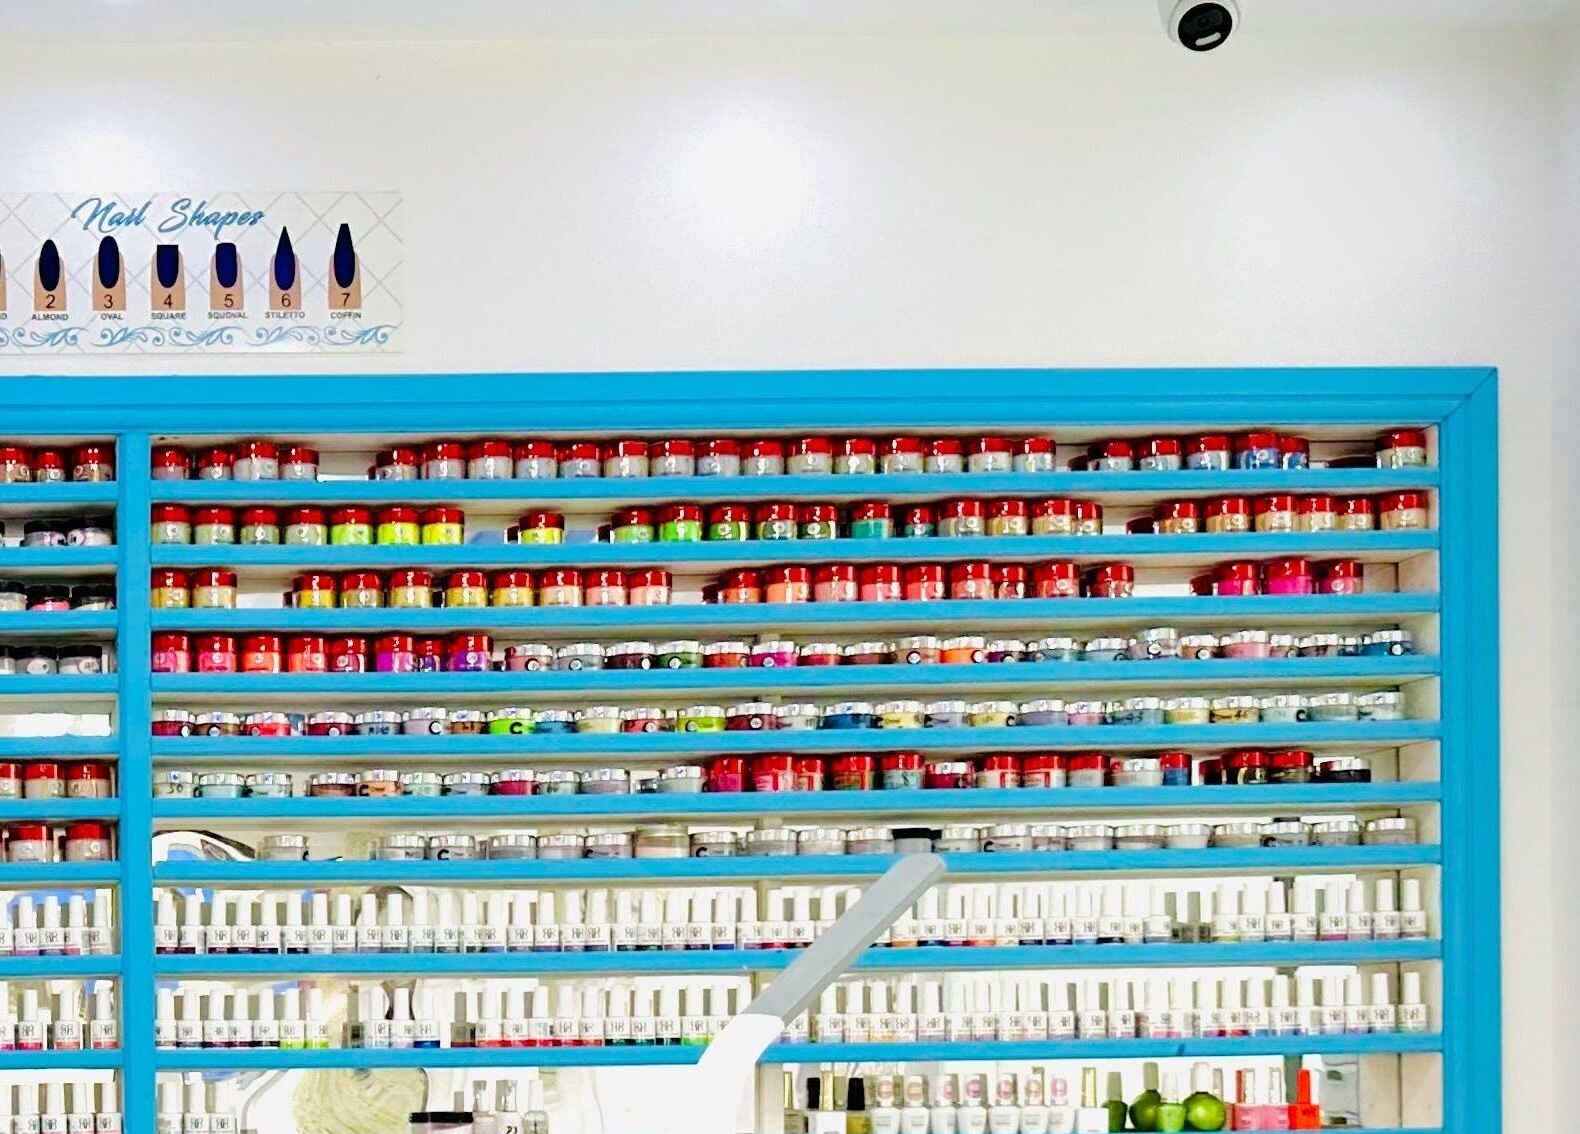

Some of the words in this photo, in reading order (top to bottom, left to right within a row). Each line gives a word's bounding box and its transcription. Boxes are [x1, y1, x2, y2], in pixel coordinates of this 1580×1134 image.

[70, 197, 152, 234] Nail
[158, 198, 265, 241] Shapes
[45, 294, 56, 309] 2
[103, 294, 114, 309] 3
[163, 293, 173, 308] 4
[224, 293, 234, 308] 5
[281, 293, 292, 308] 6
[341, 292, 351, 307] 7
[31, 313, 69, 321] ALMOND
[100, 312, 124, 321] OVAL
[151, 312, 187, 320] SQUARE
[265, 311, 306, 319] STILETTO
[330, 311, 362, 320] COFFIN
